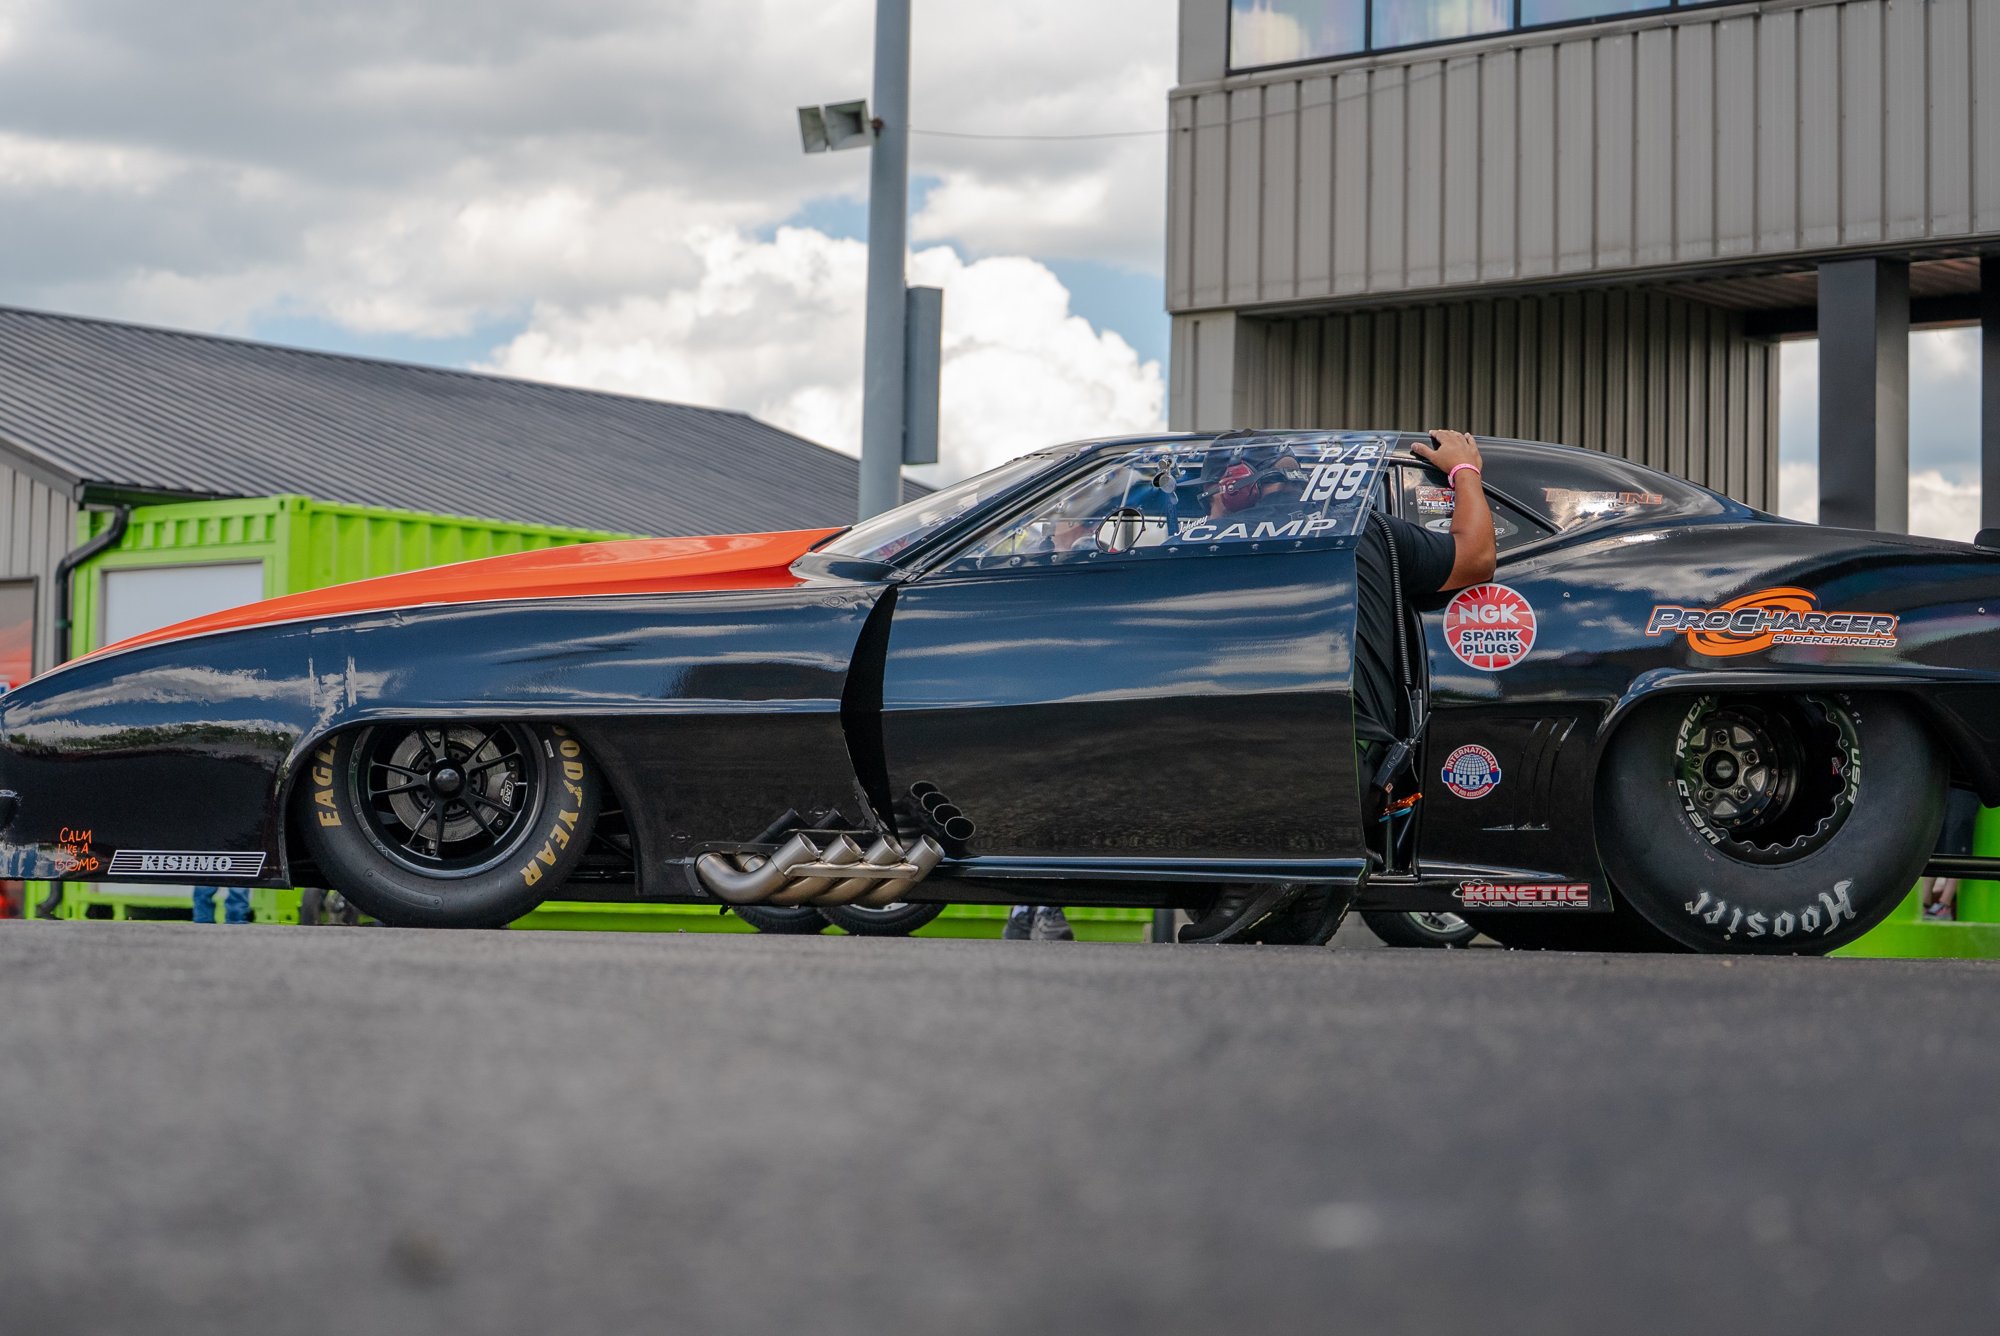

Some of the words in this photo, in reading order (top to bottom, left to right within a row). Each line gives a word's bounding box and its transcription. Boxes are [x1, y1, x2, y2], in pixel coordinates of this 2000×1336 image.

[1318, 444, 1379, 463] P/B
[1300, 462, 1369, 502] 199
[1174, 515, 1209, 536] Johnny
[1181, 518, 1337, 542] CAMP
[1458, 603, 1520, 624] NGK
[1462, 631, 1519, 642] SPARK
[1772, 635, 1897, 648] SUPERCHARGERS
[1463, 643, 1520, 654] PLUGS
[1446, 746, 1496, 770] INTERNATIONAL
[1449, 773, 1493, 785] IHRA
[1847, 747, 1861, 805] USA
[1677, 779, 1721, 845] WELD
[80, 844, 89, 854] A
[54, 855, 99, 872] BOMB
[140, 855, 232, 872] KISHMO
[1464, 885, 1588, 900] KINETIC
[1685, 878, 1857, 941] Hoosier
